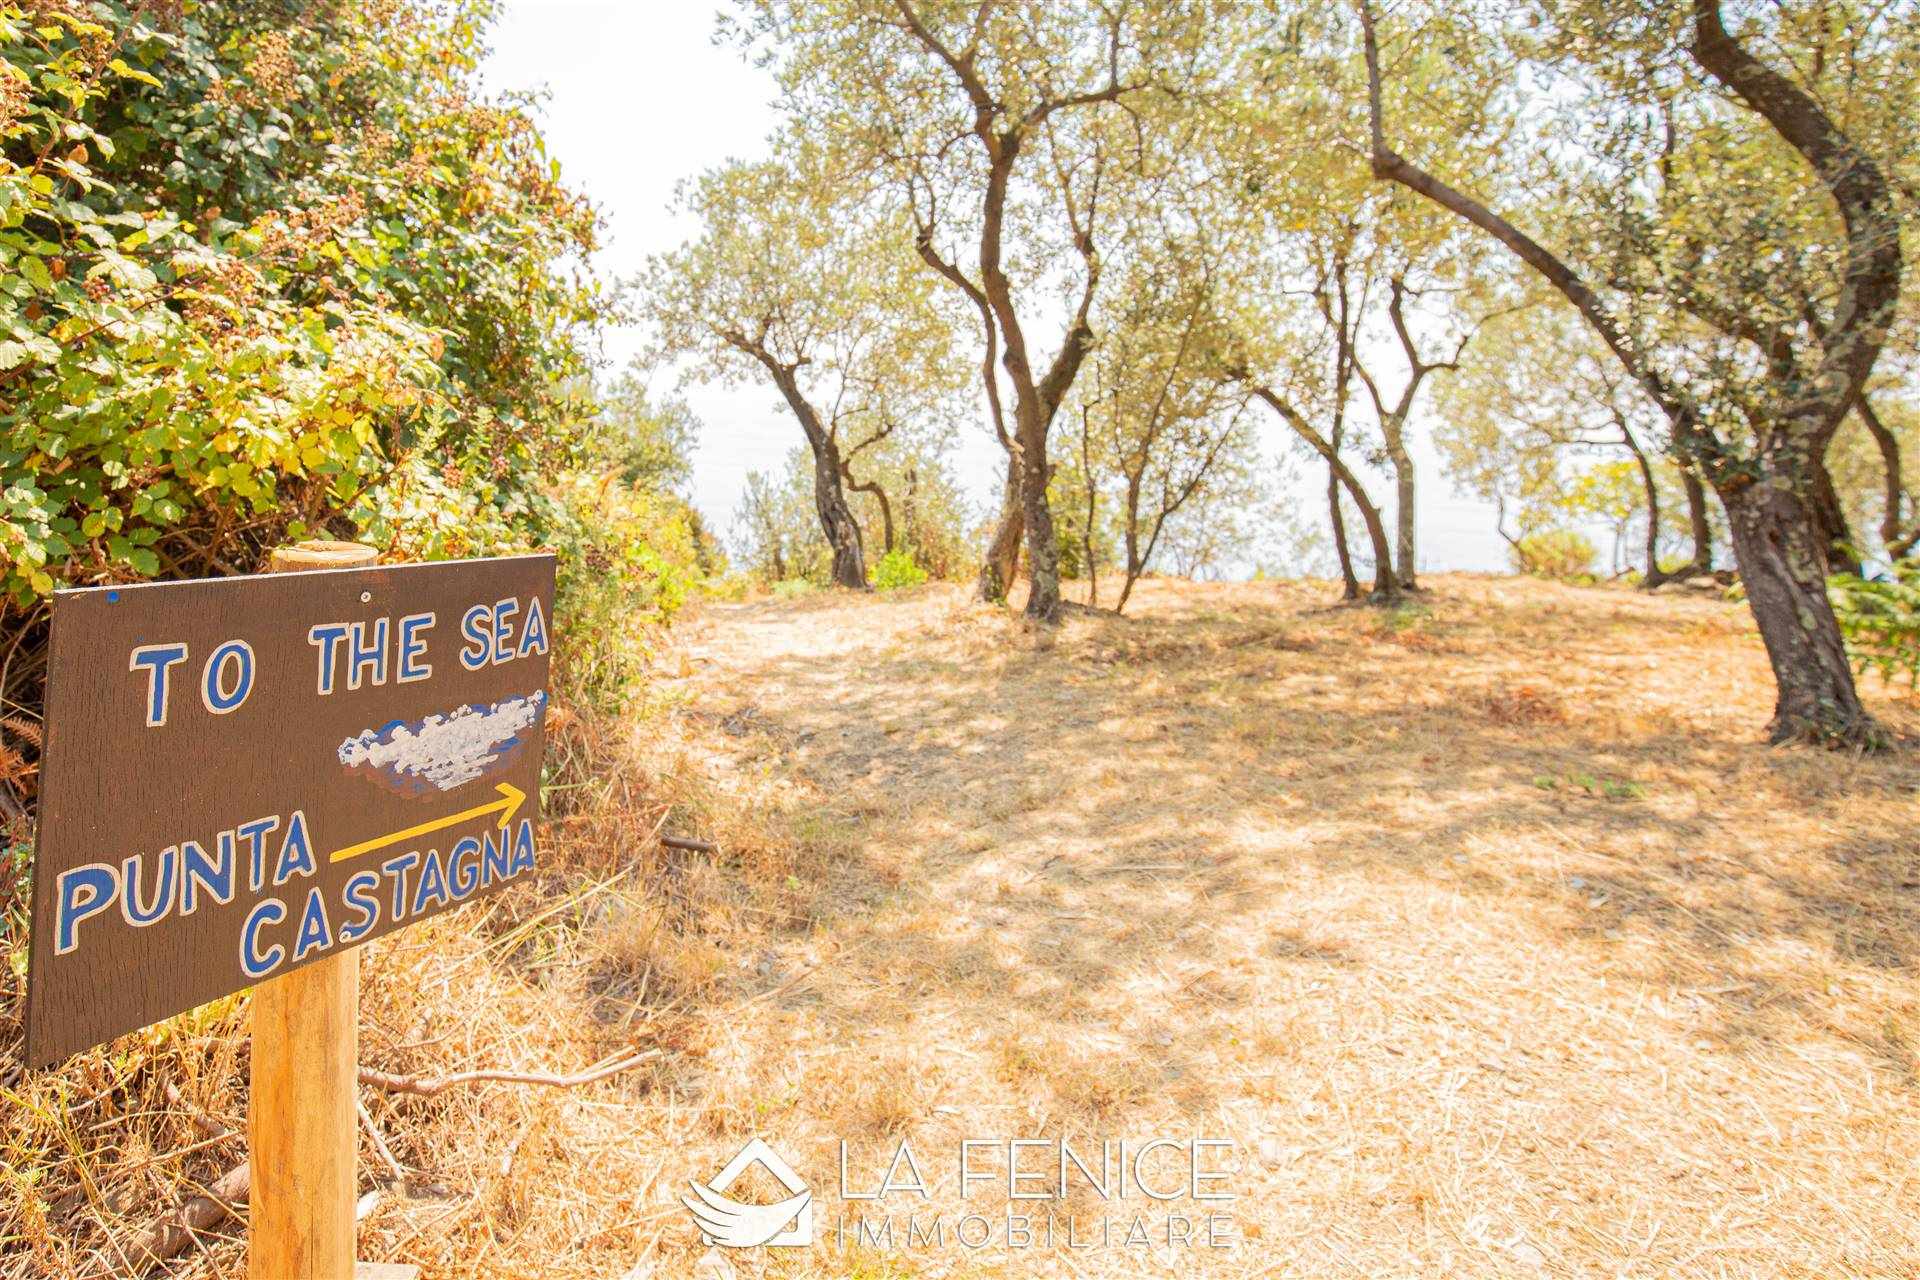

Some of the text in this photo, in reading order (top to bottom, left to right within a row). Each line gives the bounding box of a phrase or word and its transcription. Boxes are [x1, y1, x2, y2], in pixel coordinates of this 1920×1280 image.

[130, 596, 549, 727] TO THE SEA
[54, 810, 318, 956] PUNTA
[240, 818, 535, 978] CASTAGNA
